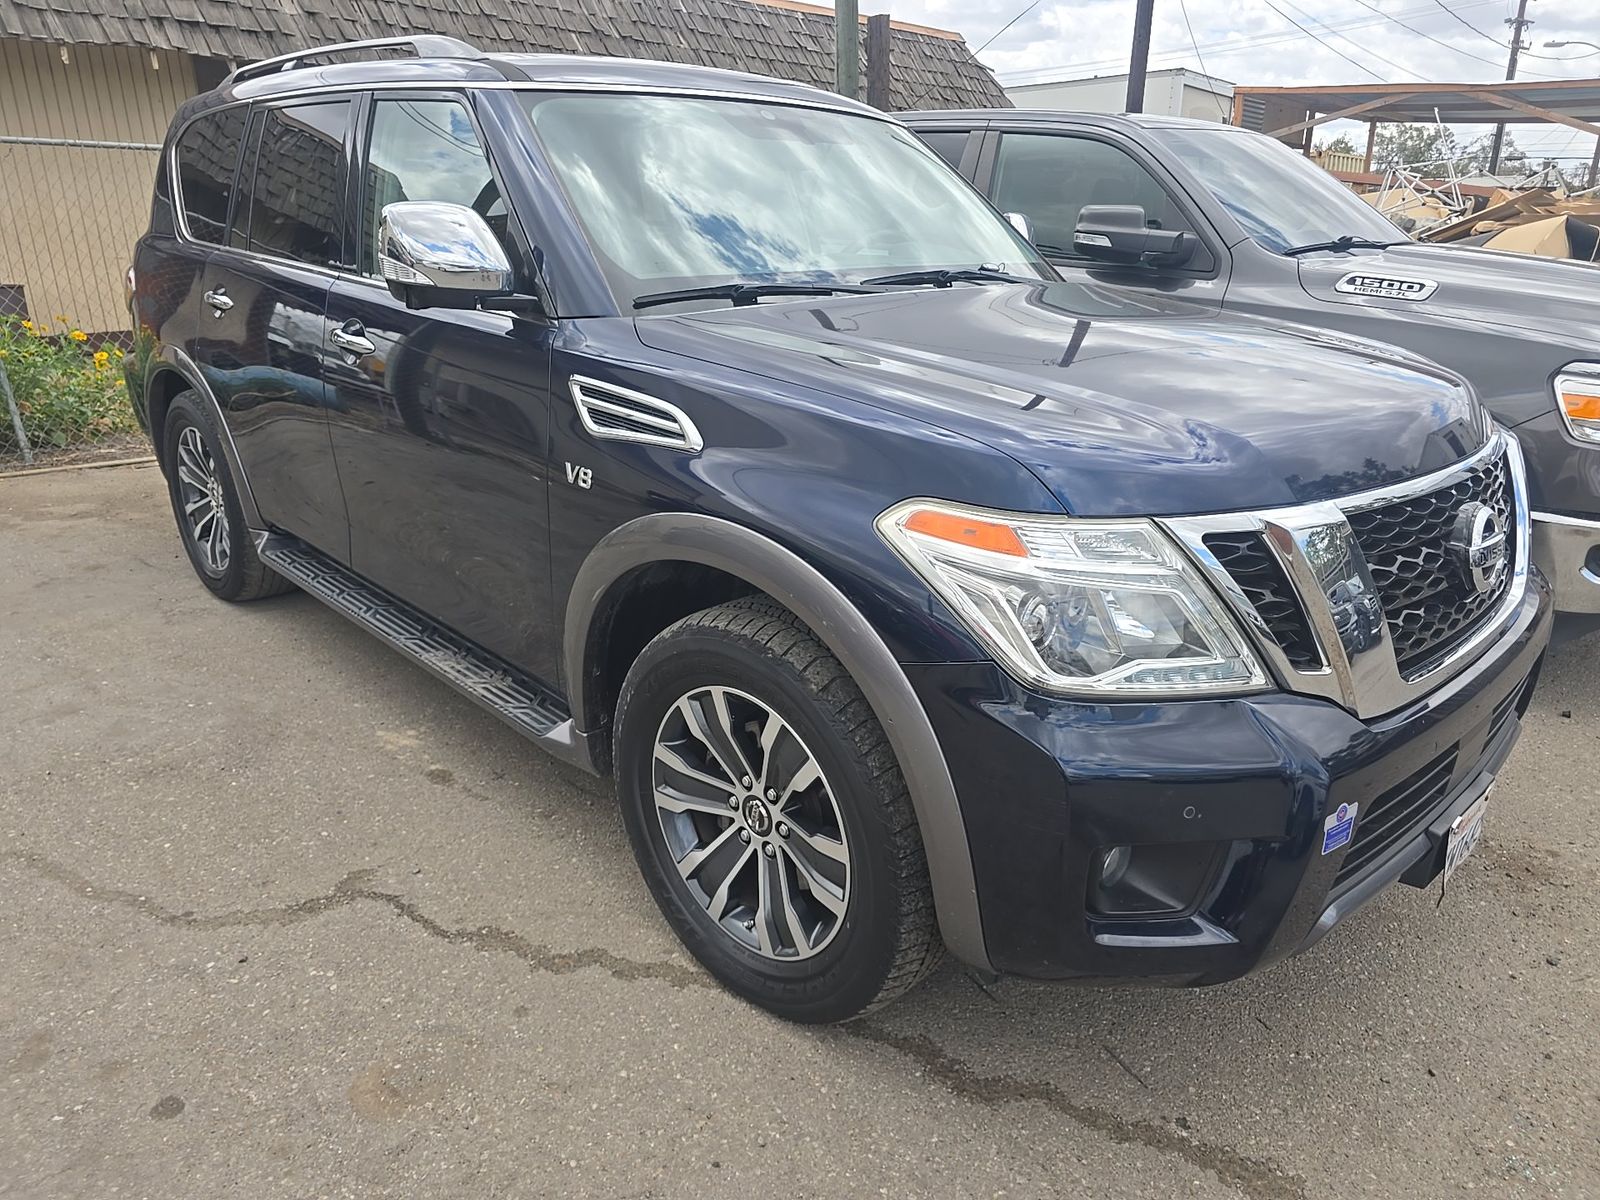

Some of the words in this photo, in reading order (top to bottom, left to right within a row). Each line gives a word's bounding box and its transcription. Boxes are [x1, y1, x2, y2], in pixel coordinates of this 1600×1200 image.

[1354, 277, 1421, 292] 1500
[1354, 286, 1382, 294] HEMI
[564, 461, 593, 490] V8
